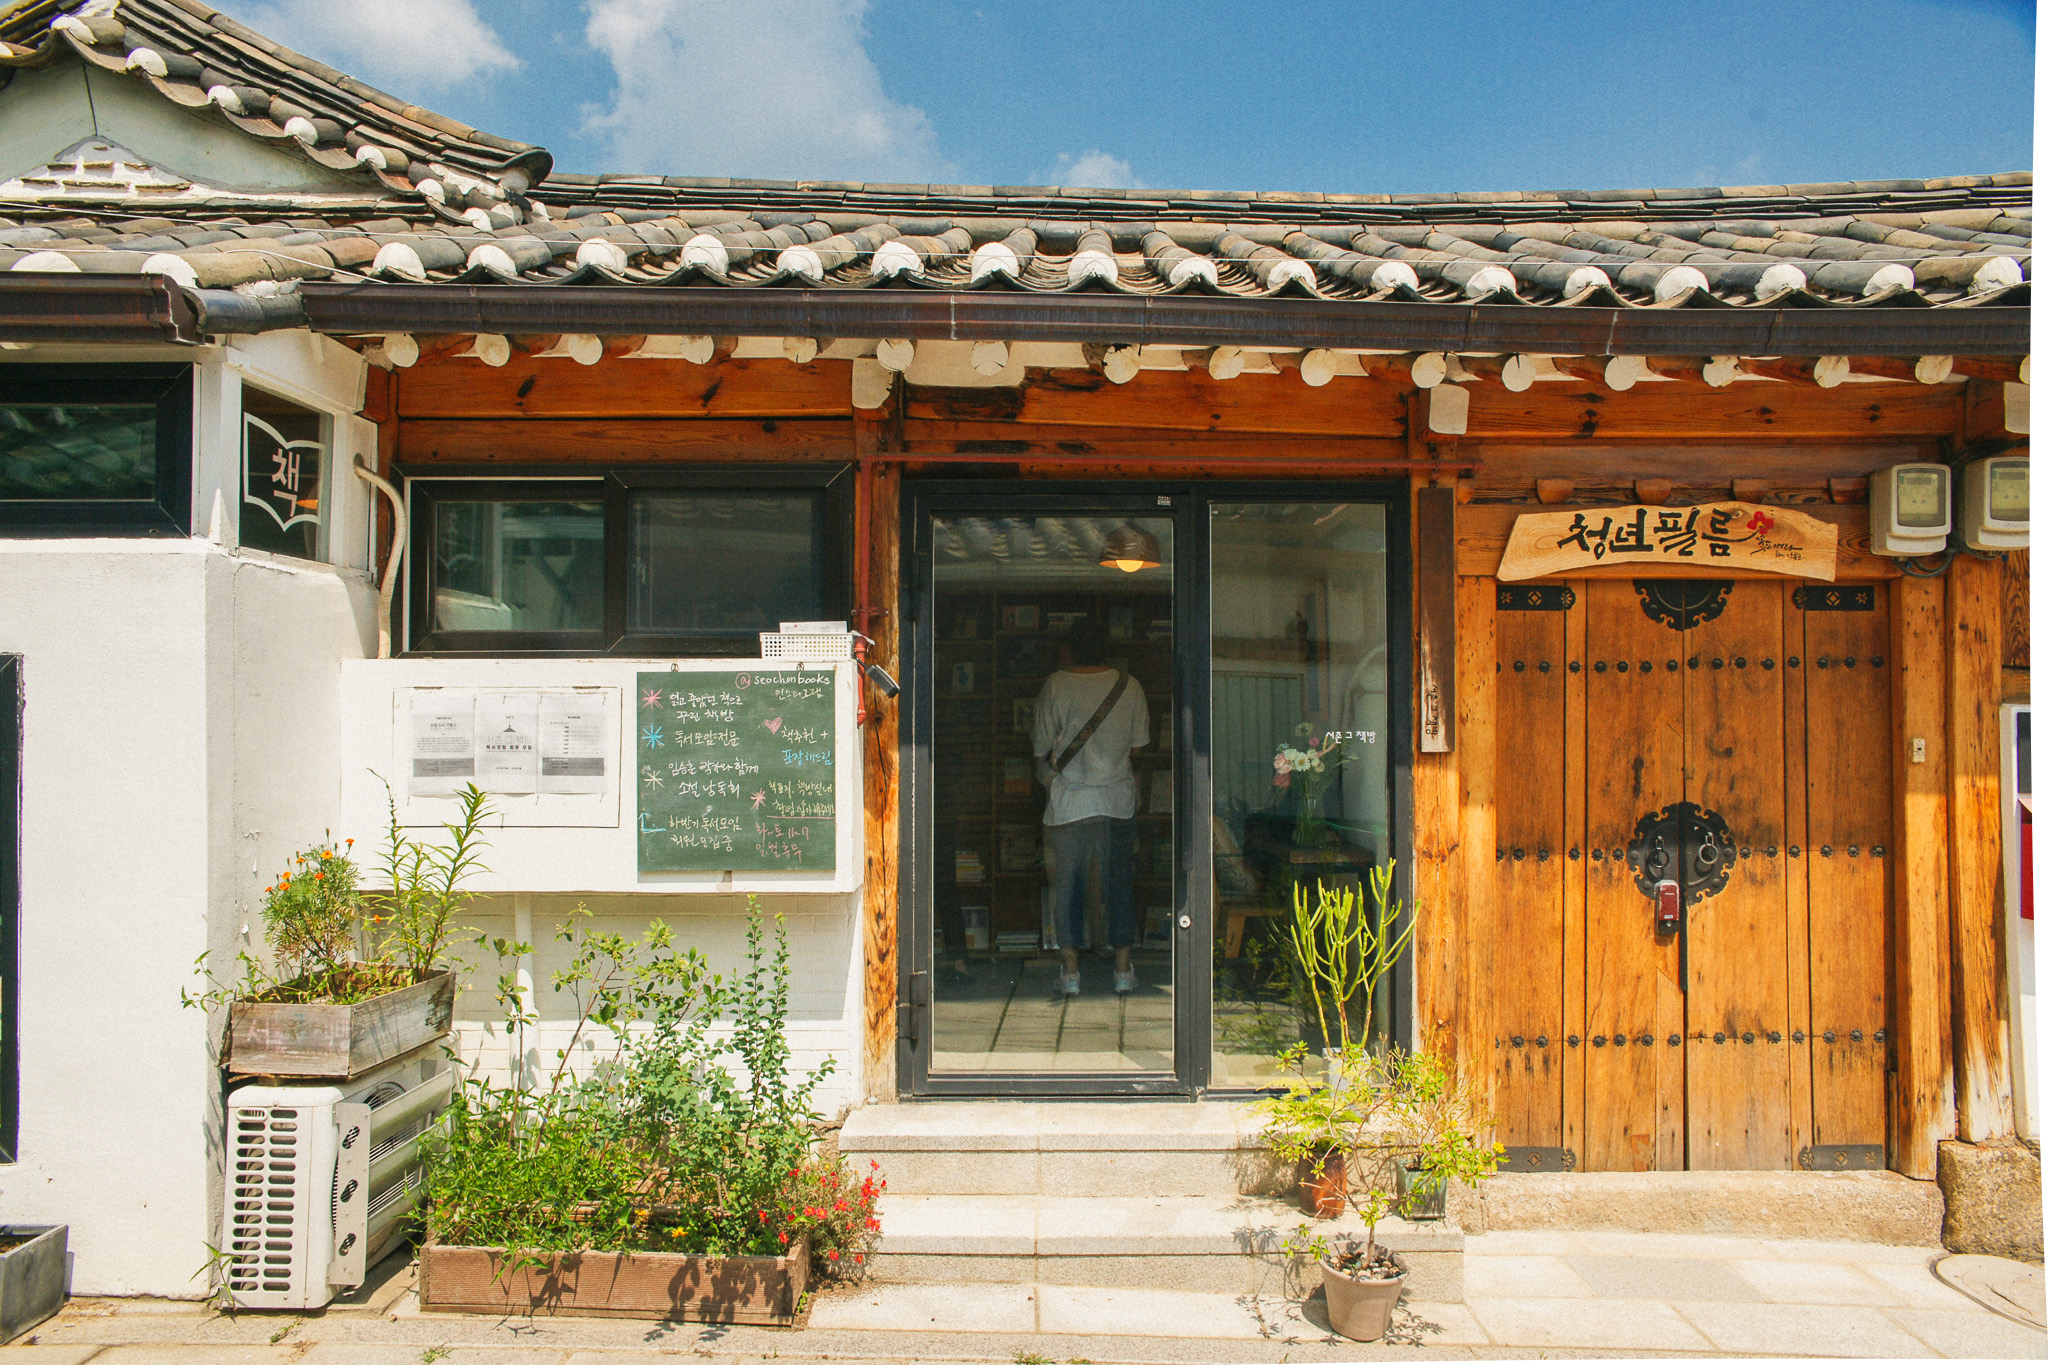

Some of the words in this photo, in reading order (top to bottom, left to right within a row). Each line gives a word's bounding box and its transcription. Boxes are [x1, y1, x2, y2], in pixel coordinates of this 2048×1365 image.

[271, 448, 300, 517] 책
[669, 691, 687, 707] 읽고
[687, 692, 719, 709] 좋았던
[719, 691, 744, 706] 책으로
[676, 710, 701, 725] 꾸린
[1325, 731, 1343, 744] 서촌
[1345, 731, 1353, 739] 그
[1355, 730, 1376, 744] 책방
[733, 756, 759, 777] 함께
[678, 781, 701, 798] 소설
[702, 779, 741, 800] 낭독회
[668, 814, 699, 830] 하반기
[700, 815, 743, 834] 독서모임
[670, 833, 700, 849] 회원
